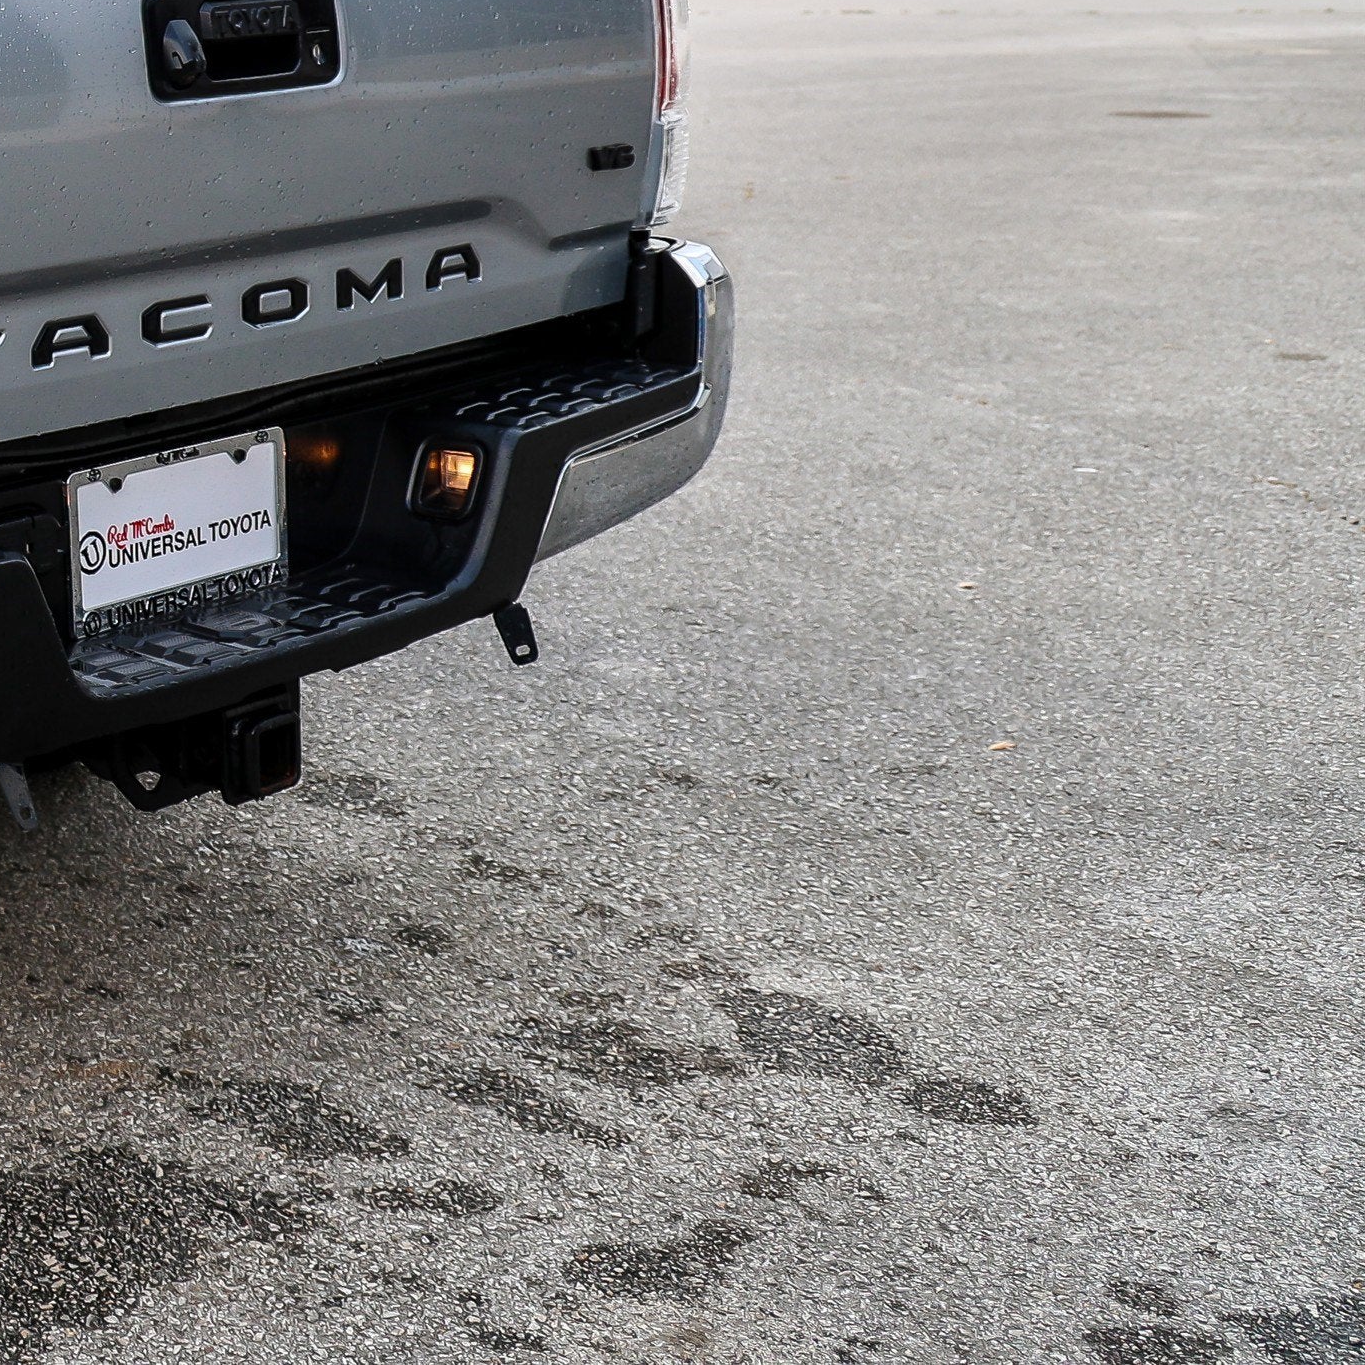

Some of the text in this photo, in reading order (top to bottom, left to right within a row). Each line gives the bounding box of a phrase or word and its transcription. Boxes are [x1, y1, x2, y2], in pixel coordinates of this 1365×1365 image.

[213, 4, 297, 37] TOYOTA
[107, 523, 129, 550] Red
[109, 509, 272, 569] UNIVERSAL TOYOTA
[107, 582, 214, 628] UNIVERSAL
[215, 562, 283, 601] TOYOTA
